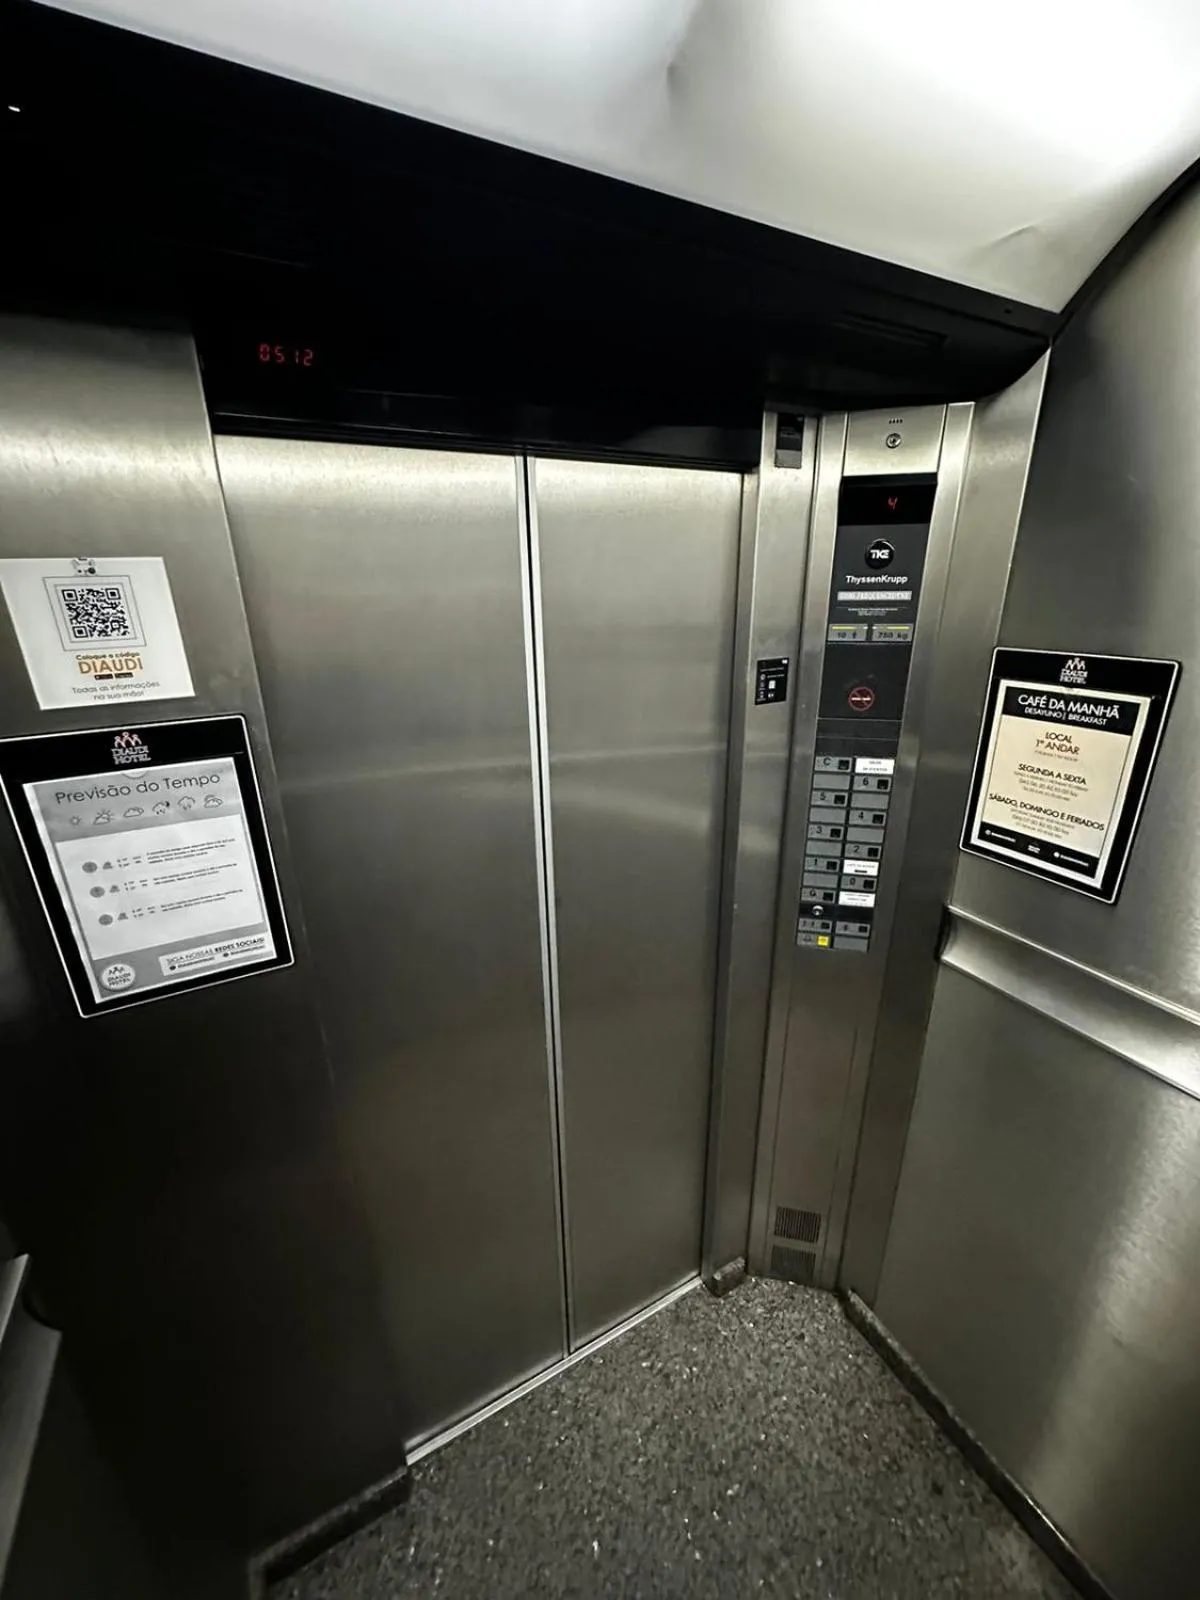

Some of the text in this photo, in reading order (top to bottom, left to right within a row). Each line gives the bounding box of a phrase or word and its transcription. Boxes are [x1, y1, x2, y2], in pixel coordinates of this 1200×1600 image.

[887, 497, 898, 510] 4
[870, 549, 890, 559] TKE
[846, 574, 908, 585] ThyssenKrupp
[78, 657, 144, 674] DIAUDI
[1060, 675, 1086, 684] HOTEL
[72, 686, 98, 694] Todas
[110, 681, 160, 691] informações
[1018, 694, 1120, 719] CAFÉ DA MANHÃ
[1024, 707, 1063, 719] DESAYUNO
[1068, 713, 1108, 726] BREAKFAST
[1045, 732, 1073, 744] LOCAL
[111, 745, 149, 757] DIAUDI
[1045, 741, 1080, 755] ANDAR
[113, 753, 151, 765] HOTEL
[823, 757, 832, 766] C
[1018, 763, 1055, 777] SEGUNDA
[1055, 772, 1063, 780] A
[1063, 773, 1087, 785] SEXTA
[862, 777, 869, 786] 6
[55, 774, 220, 804] Previsão do Tempo
[819, 792, 826, 801] 5
[1019, 801, 1060, 818] DOMINGO
[1066, 814, 1105, 831] FERIADOS
[815, 826, 822, 834] 3
[185, 948, 214, 961] NOSSAS
[214, 943, 235, 953] REDES
